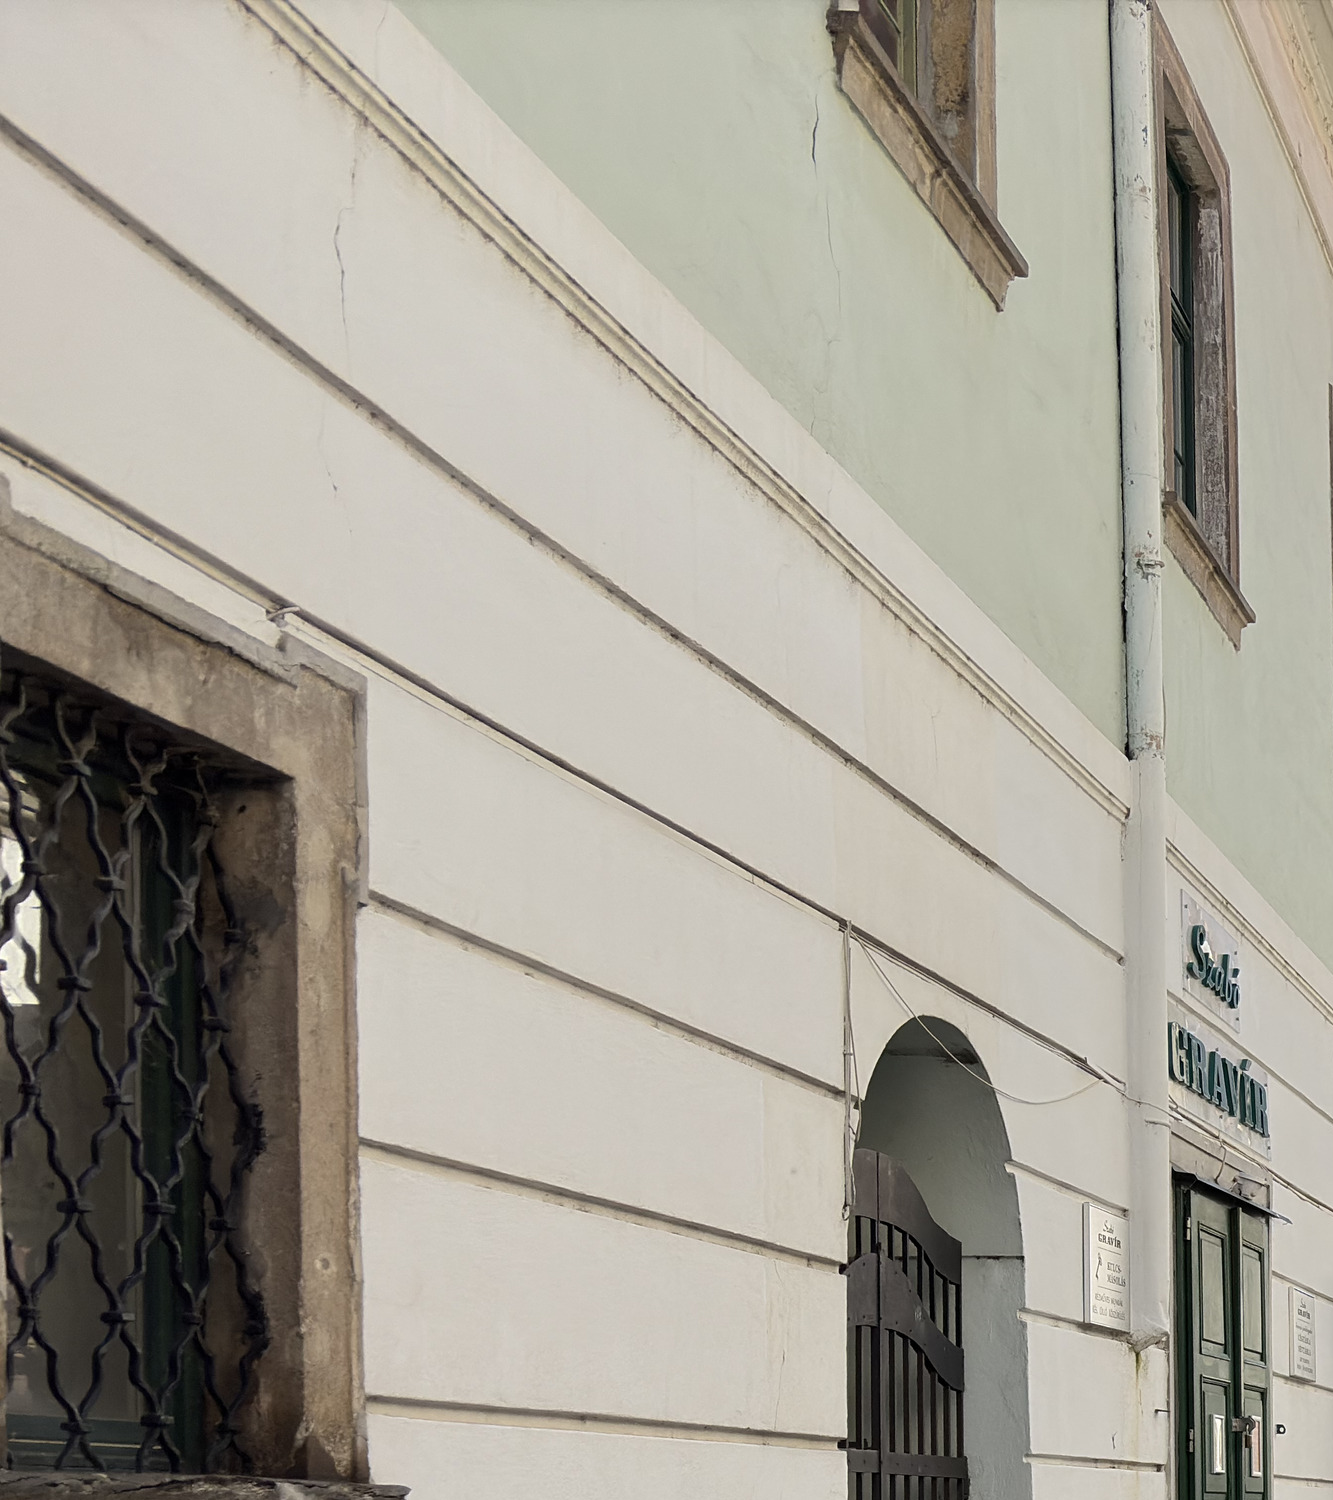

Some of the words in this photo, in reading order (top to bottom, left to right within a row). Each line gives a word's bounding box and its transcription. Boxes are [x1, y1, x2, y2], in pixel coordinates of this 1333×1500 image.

[1186, 924, 1240, 1009] Szabó
[1167, 1021, 1270, 1138] GRAVÍR
[1097, 1233, 1122, 1250] GRAVÍR
